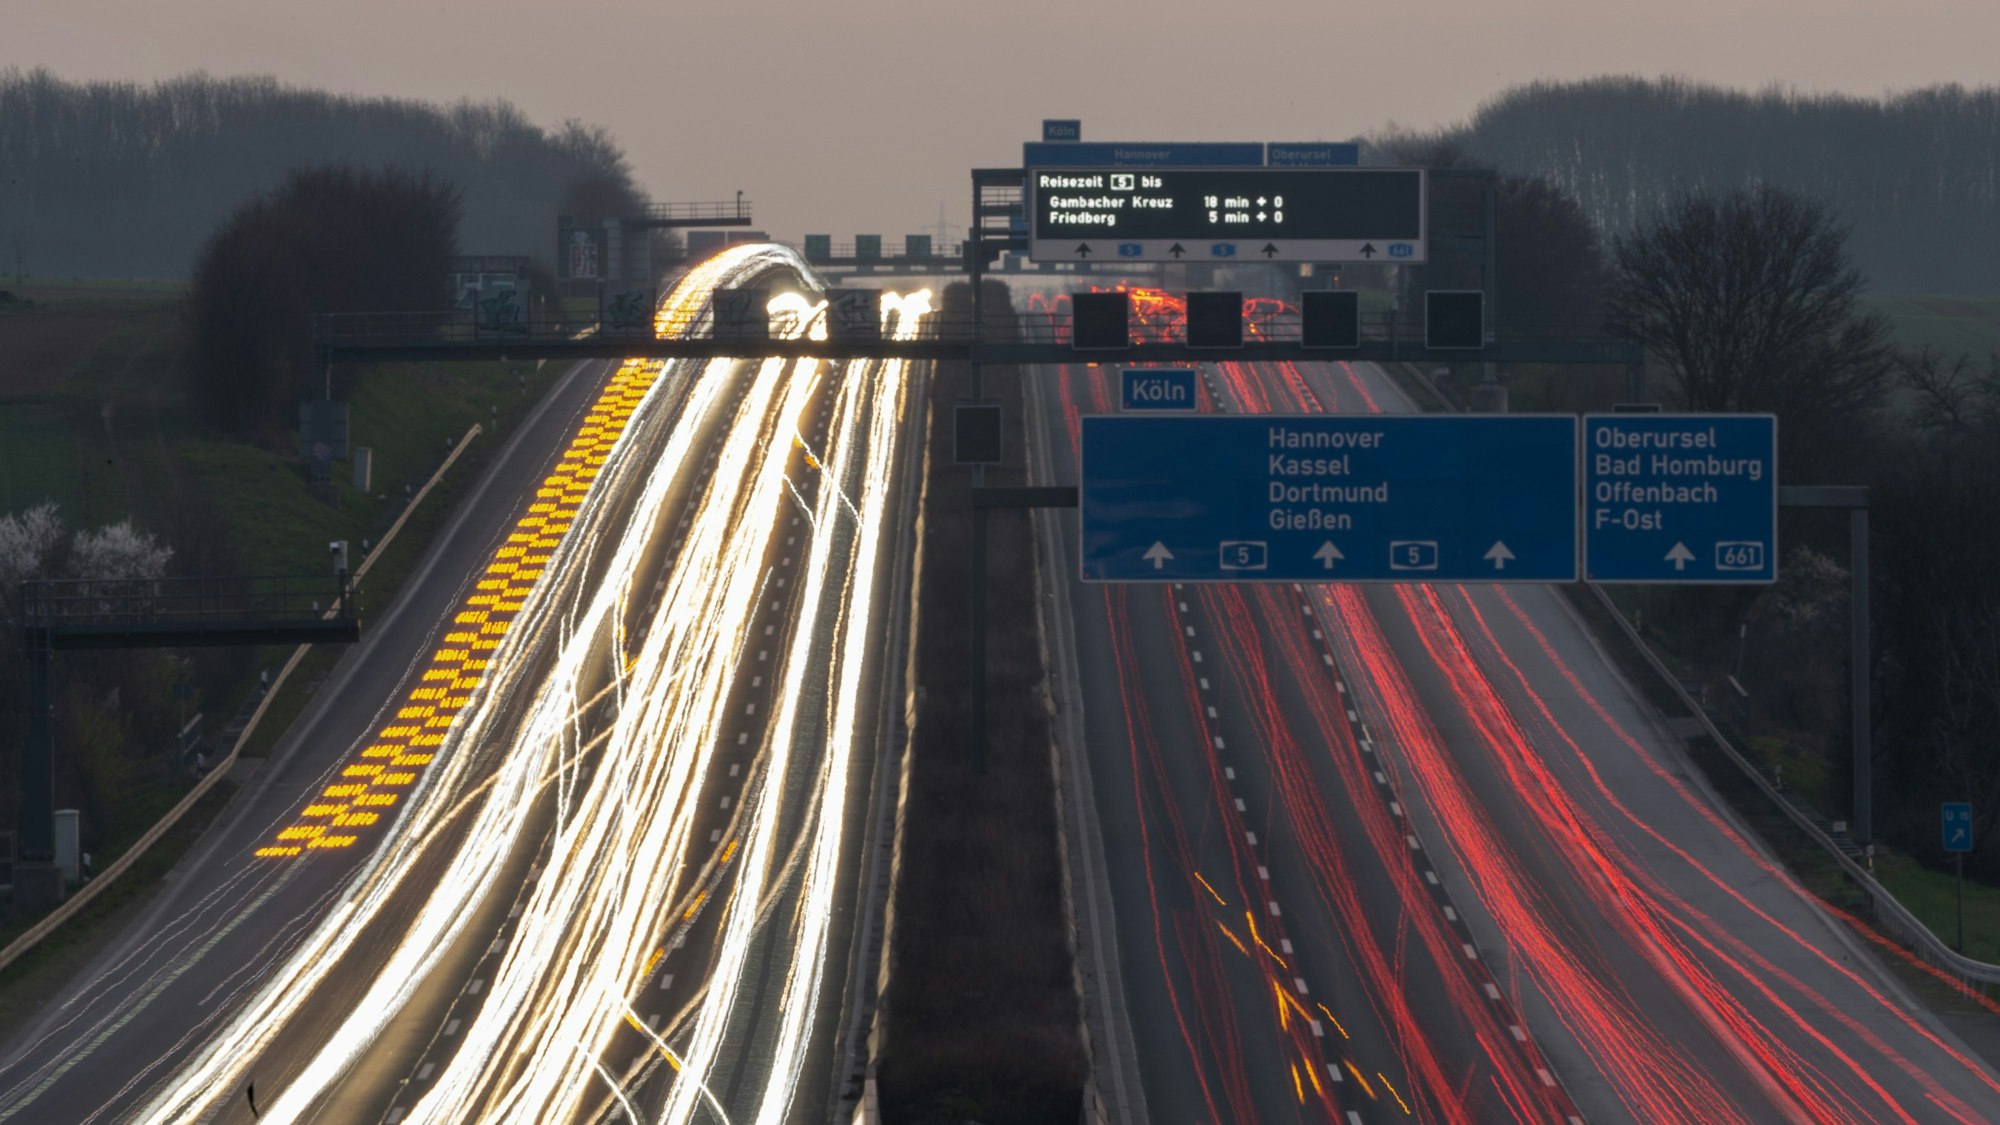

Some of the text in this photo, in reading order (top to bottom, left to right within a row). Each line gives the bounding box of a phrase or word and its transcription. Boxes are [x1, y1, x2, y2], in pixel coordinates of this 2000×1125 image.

[1049, 126, 1075, 137] Köln
[1115, 148, 1171, 160] Hannover
[1272, 148, 1331, 160] Oberursel
[1040, 176, 1162, 187] Reisezeit 5 bis
[1050, 195, 1282, 208] Gambacher Kreuz 18 min + 0
[1050, 211, 1282, 226] Friedberg 5 min + 0
[1392, 245, 1409, 255] 661
[1133, 380, 1185, 400] Köln
[1270, 428, 1383, 448] Hannover
[1596, 427, 1716, 448] Oberursel
[1270, 455, 1349, 475] Kassel
[1596, 454, 1762, 480] Bad Homburg
[1270, 481, 1387, 502] Dortmund
[1596, 482, 1717, 502] Offenbach
[1270, 509, 1351, 529] Gießen
[1596, 509, 1661, 530] F-Ost
[1238, 547, 1249, 564] 5
[1409, 547, 1420, 564] 5
[1725, 547, 1755, 564] 661
